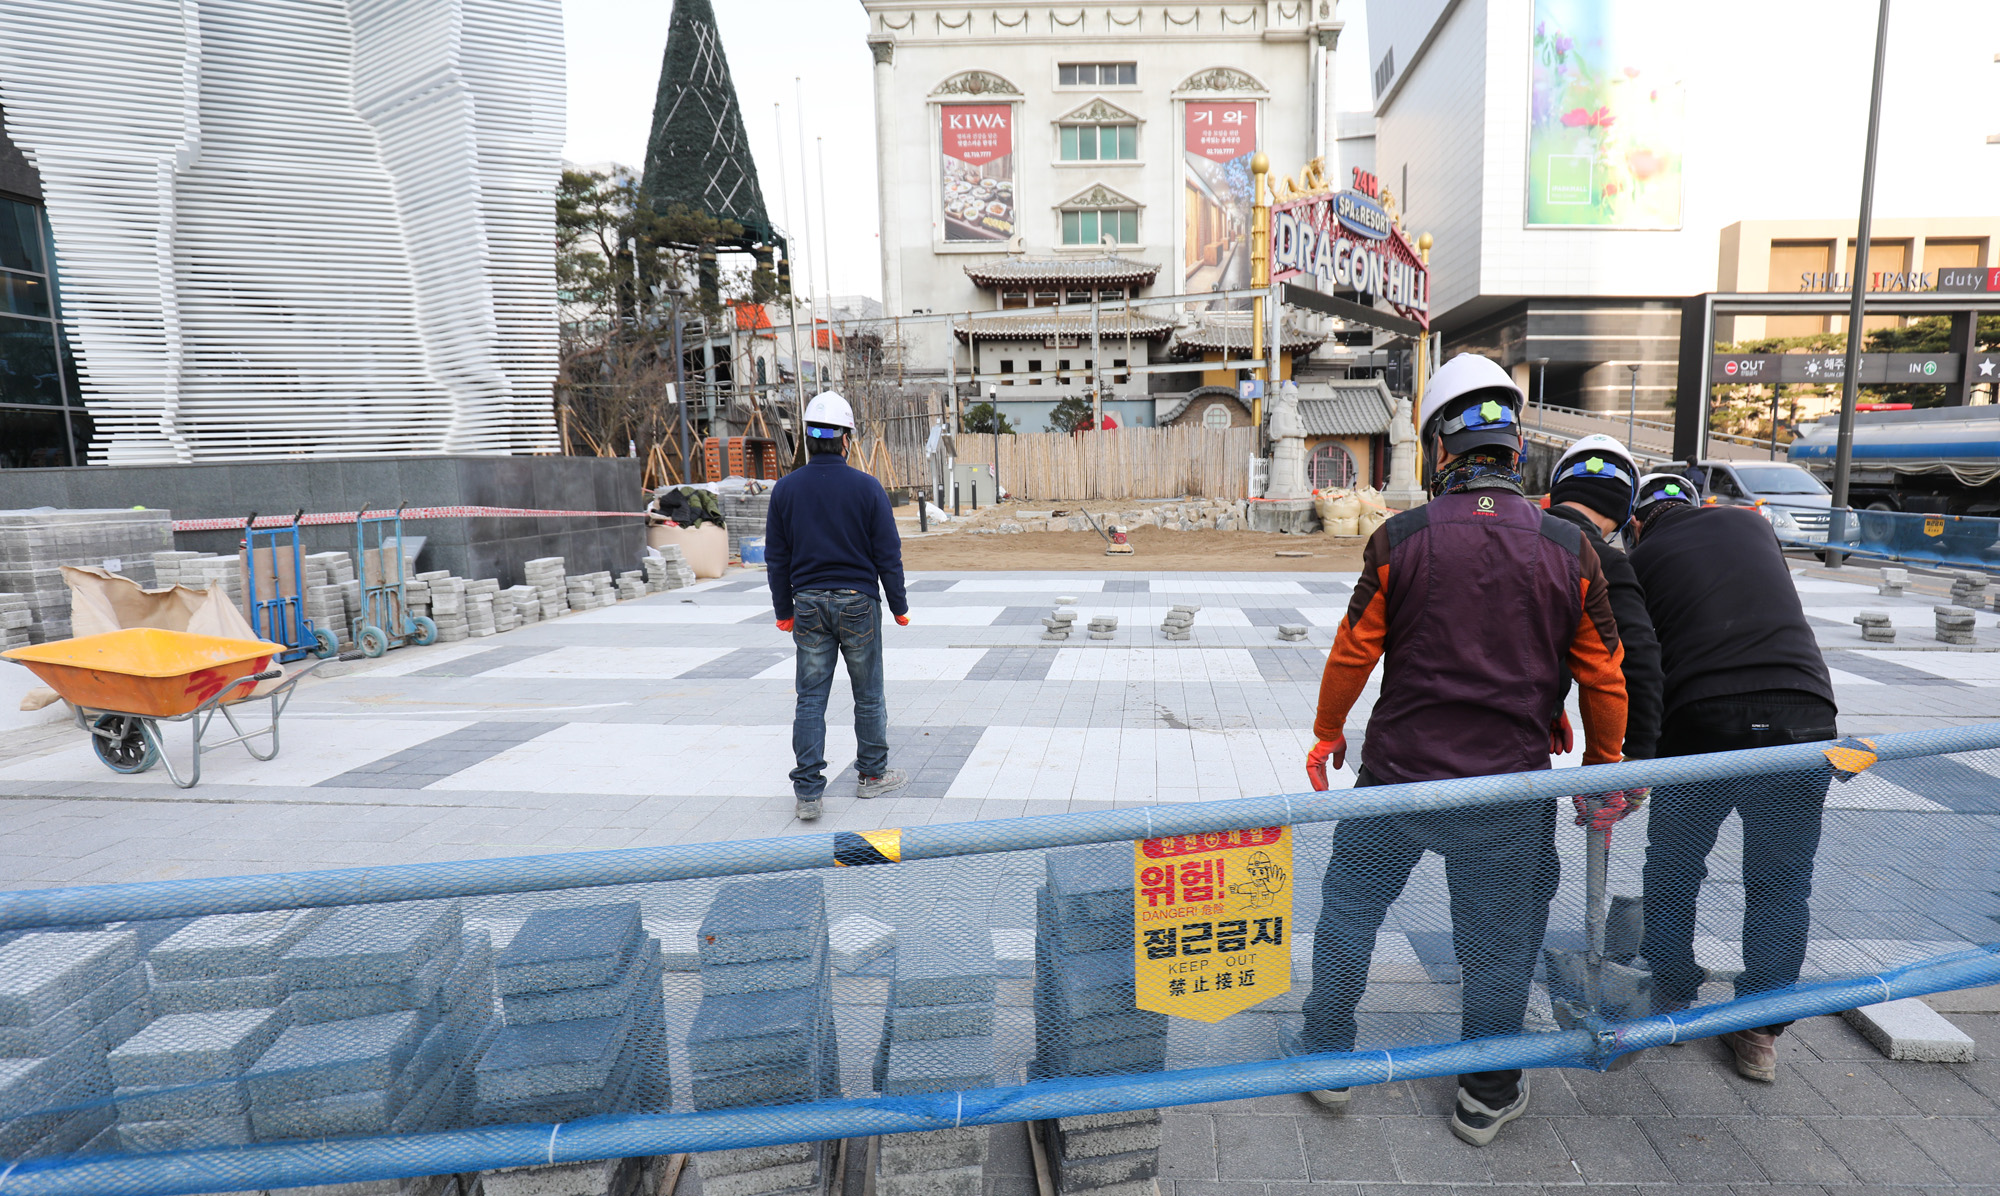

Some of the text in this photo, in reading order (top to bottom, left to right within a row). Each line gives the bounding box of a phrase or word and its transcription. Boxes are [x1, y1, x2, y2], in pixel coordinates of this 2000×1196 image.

[948, 113, 1007, 129] KIWA
[1353, 166, 1379, 199] 24H
[1277, 211, 1429, 312] DRAGON HILL
[1872, 271, 1933, 289] IPARK
[1944, 271, 1984, 291] duty
[1740, 360, 1765, 370] OUT
[1908, 363, 1922, 373] IN
[1242, 382, 1255, 397] P
[1140, 858, 1225, 907] 위험!
[1142, 906, 1198, 922] DANGER!
[1142, 916, 1283, 960] 접근금지
[1168, 953, 1257, 975] KEEP OUT
